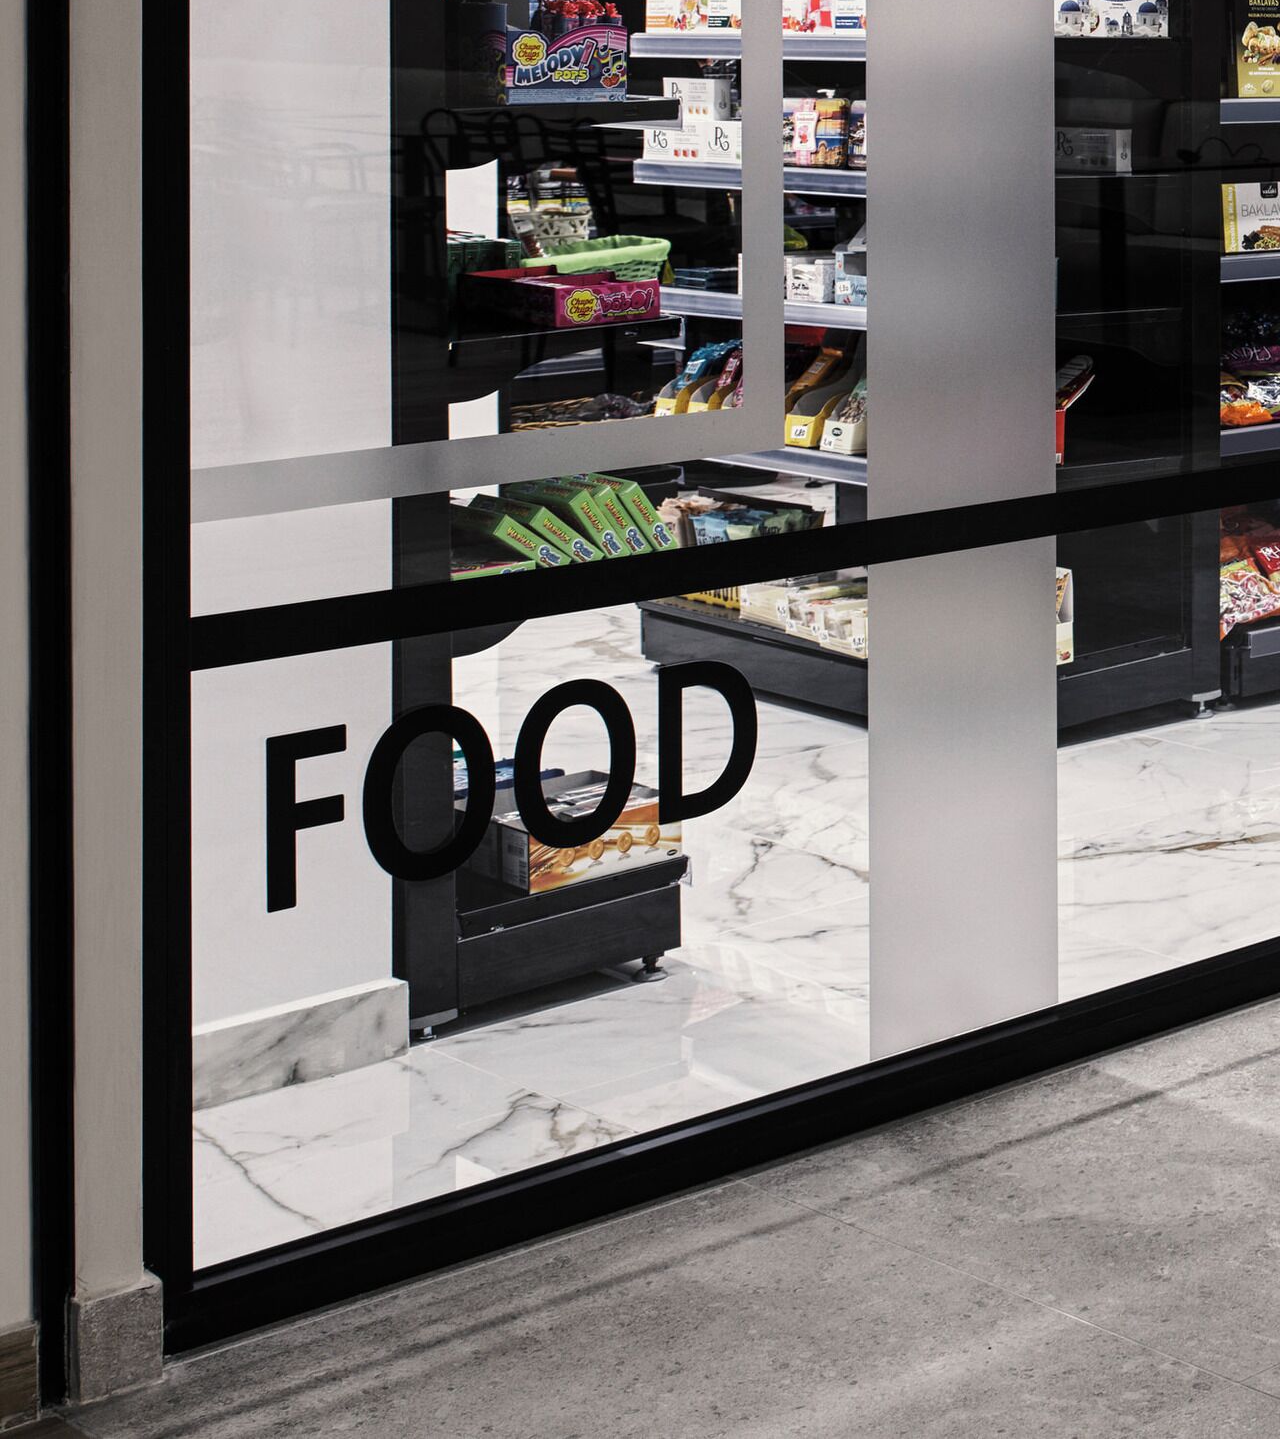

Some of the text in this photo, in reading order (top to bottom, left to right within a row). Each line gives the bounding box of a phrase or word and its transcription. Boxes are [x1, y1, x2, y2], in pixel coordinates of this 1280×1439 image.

[517, 45, 586, 84] MELODY
[554, 70, 587, 81] POPS
[266, 660, 758, 913] FOOD
